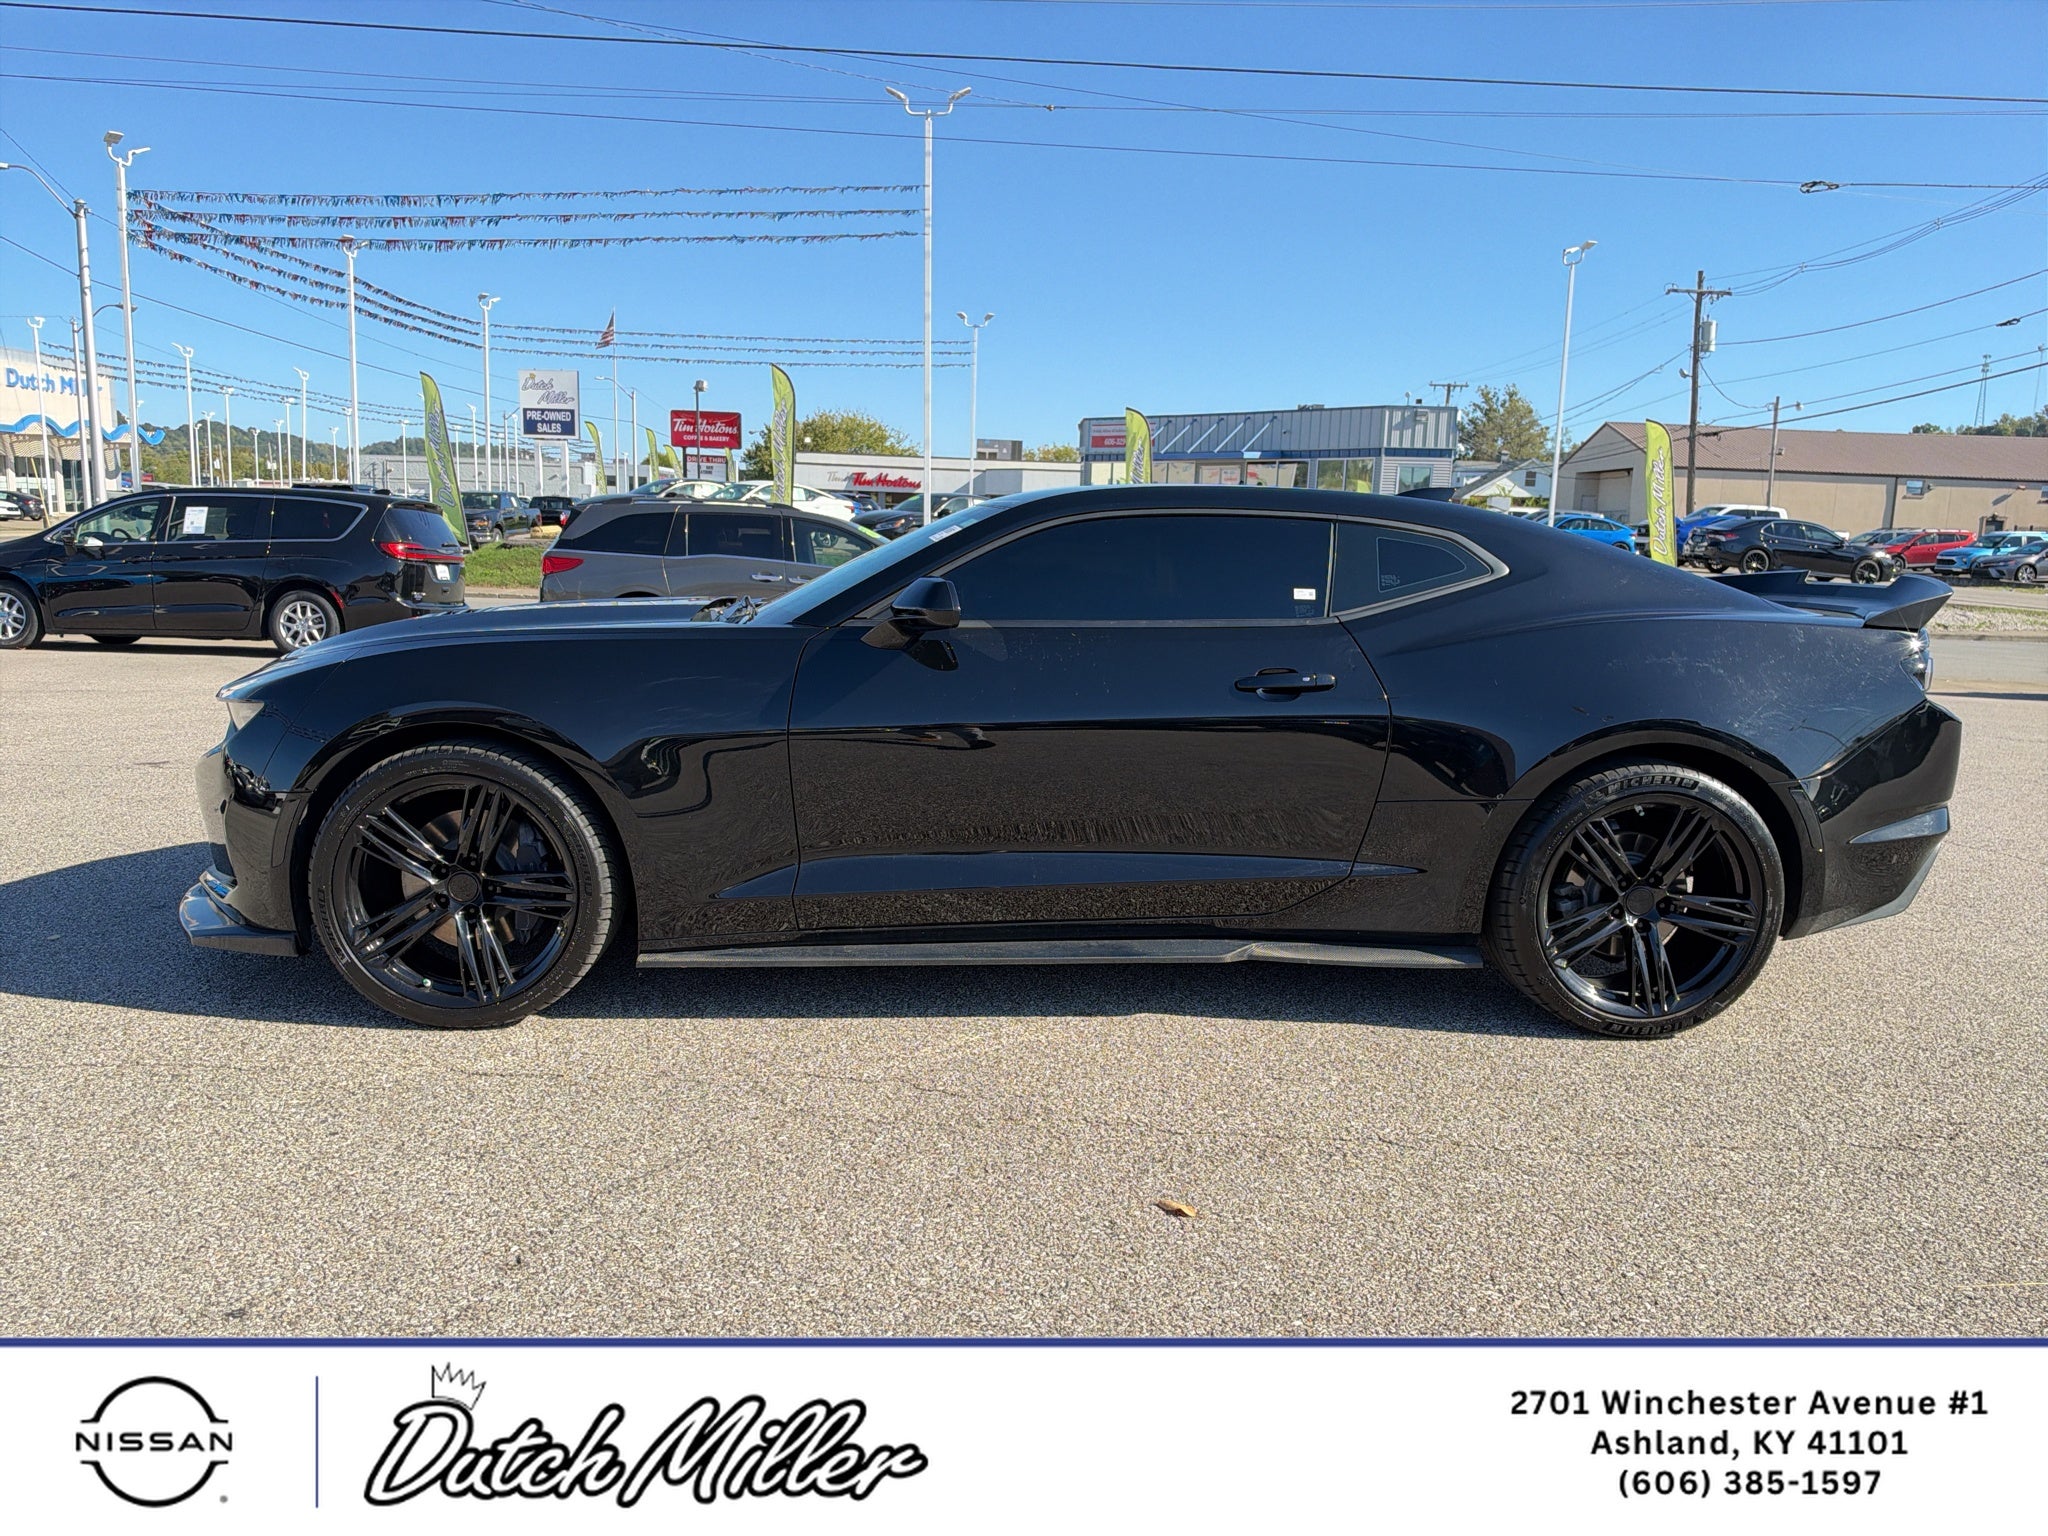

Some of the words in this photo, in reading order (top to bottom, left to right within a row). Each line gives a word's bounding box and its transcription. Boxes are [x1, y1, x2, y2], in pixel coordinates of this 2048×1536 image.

[521, 376, 554, 391] Dutch
[536, 390, 575, 405] Miller
[526, 410, 571, 422] PRE-OWNED
[537, 422, 562, 433] SALES
[673, 418, 694, 432] Tim
[695, 419, 738, 434] Hortons
[852, 472, 874, 487] Tim
[874, 472, 922, 489] Hortons
[1652, 447, 1667, 506] Miller
[1653, 507, 1667, 555] Dutch
[1607, 775, 1697, 794] MICHELIN
